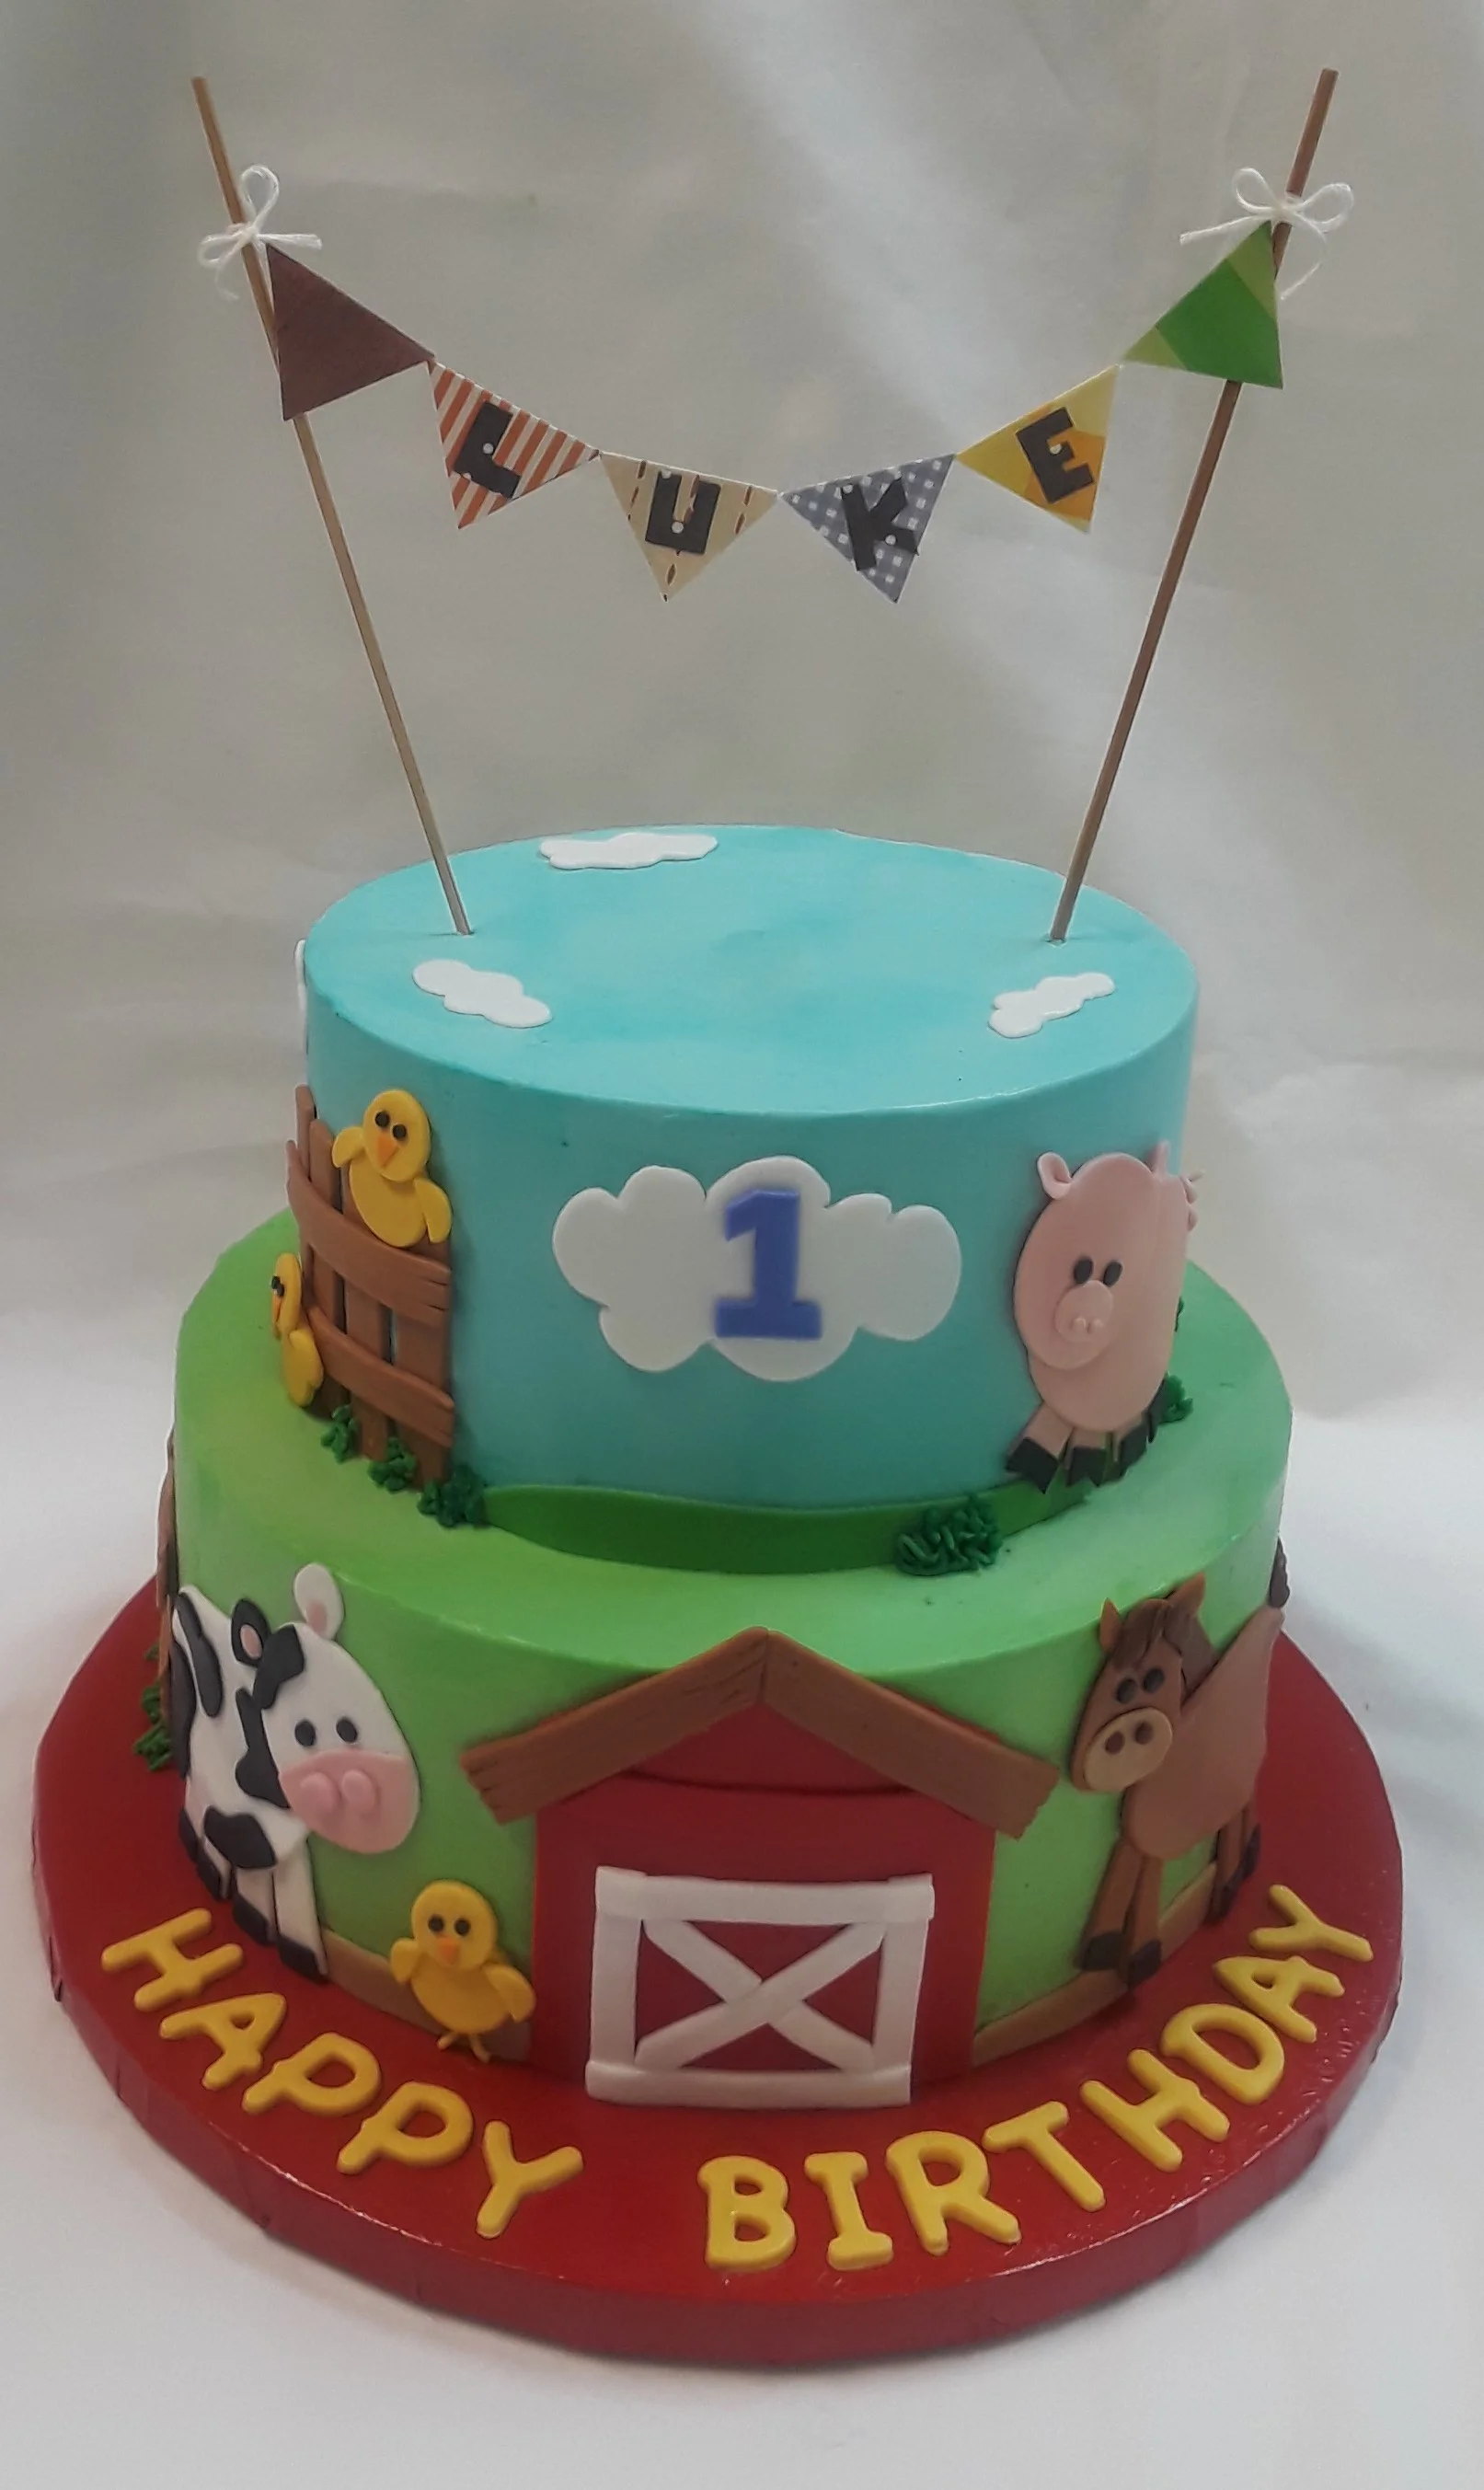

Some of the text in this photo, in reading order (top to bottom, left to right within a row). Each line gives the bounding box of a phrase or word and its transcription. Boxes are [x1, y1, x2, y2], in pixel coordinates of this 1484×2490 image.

[455, 401, 1095, 572] LUKE
[714, 1188, 823, 1341] 1
[101, 1885, 1374, 2271] HAPPY BIRTHDAY
